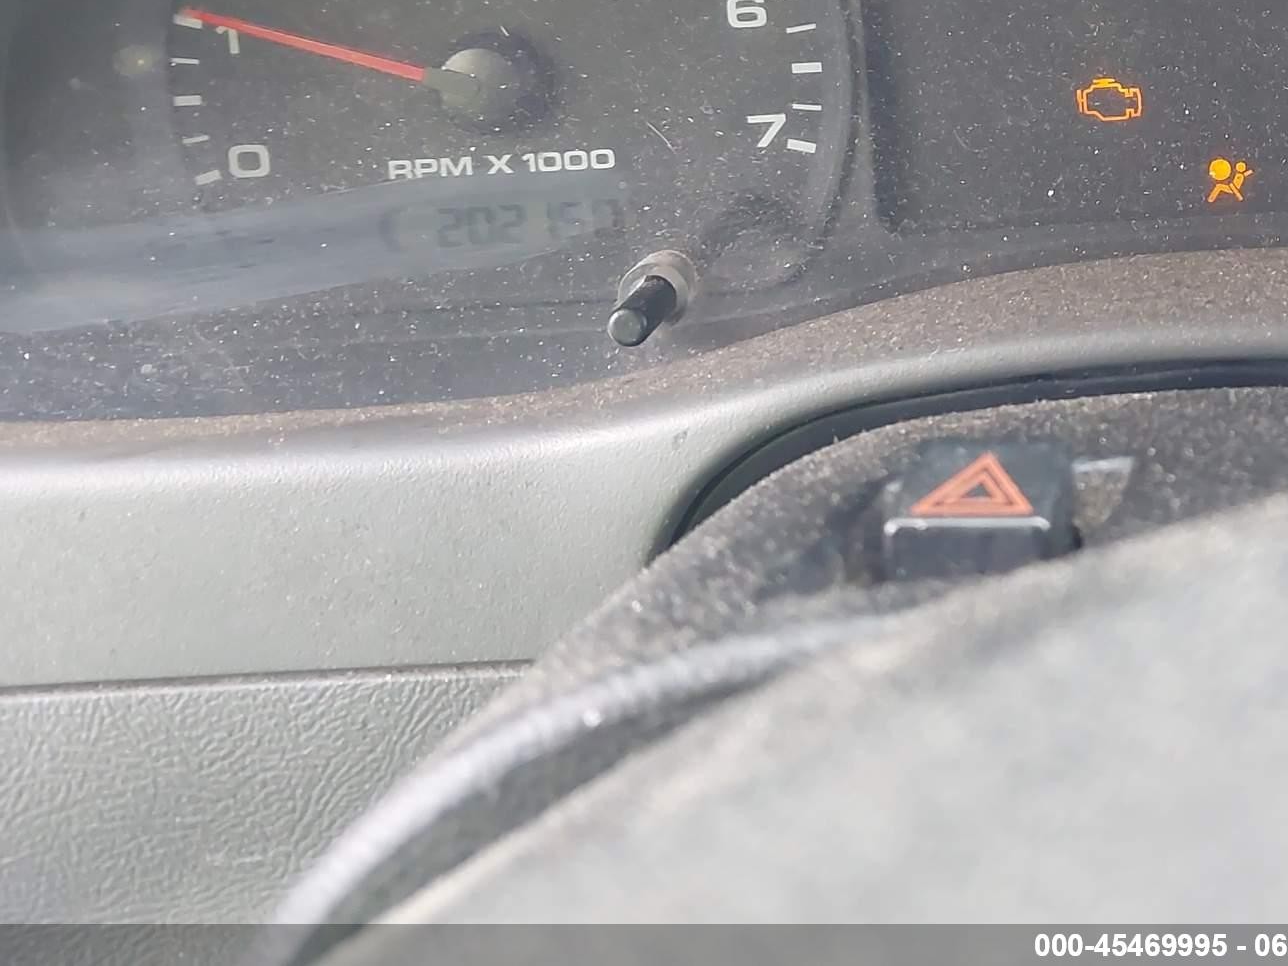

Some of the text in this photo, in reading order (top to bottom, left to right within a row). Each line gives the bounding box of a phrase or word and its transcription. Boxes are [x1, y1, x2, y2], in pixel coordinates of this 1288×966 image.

[216, 25, 240, 55] 1
[746, 114, 787, 147] 7
[228, 145, 270, 178] 0
[388, 149, 616, 180] RPM X 1000
